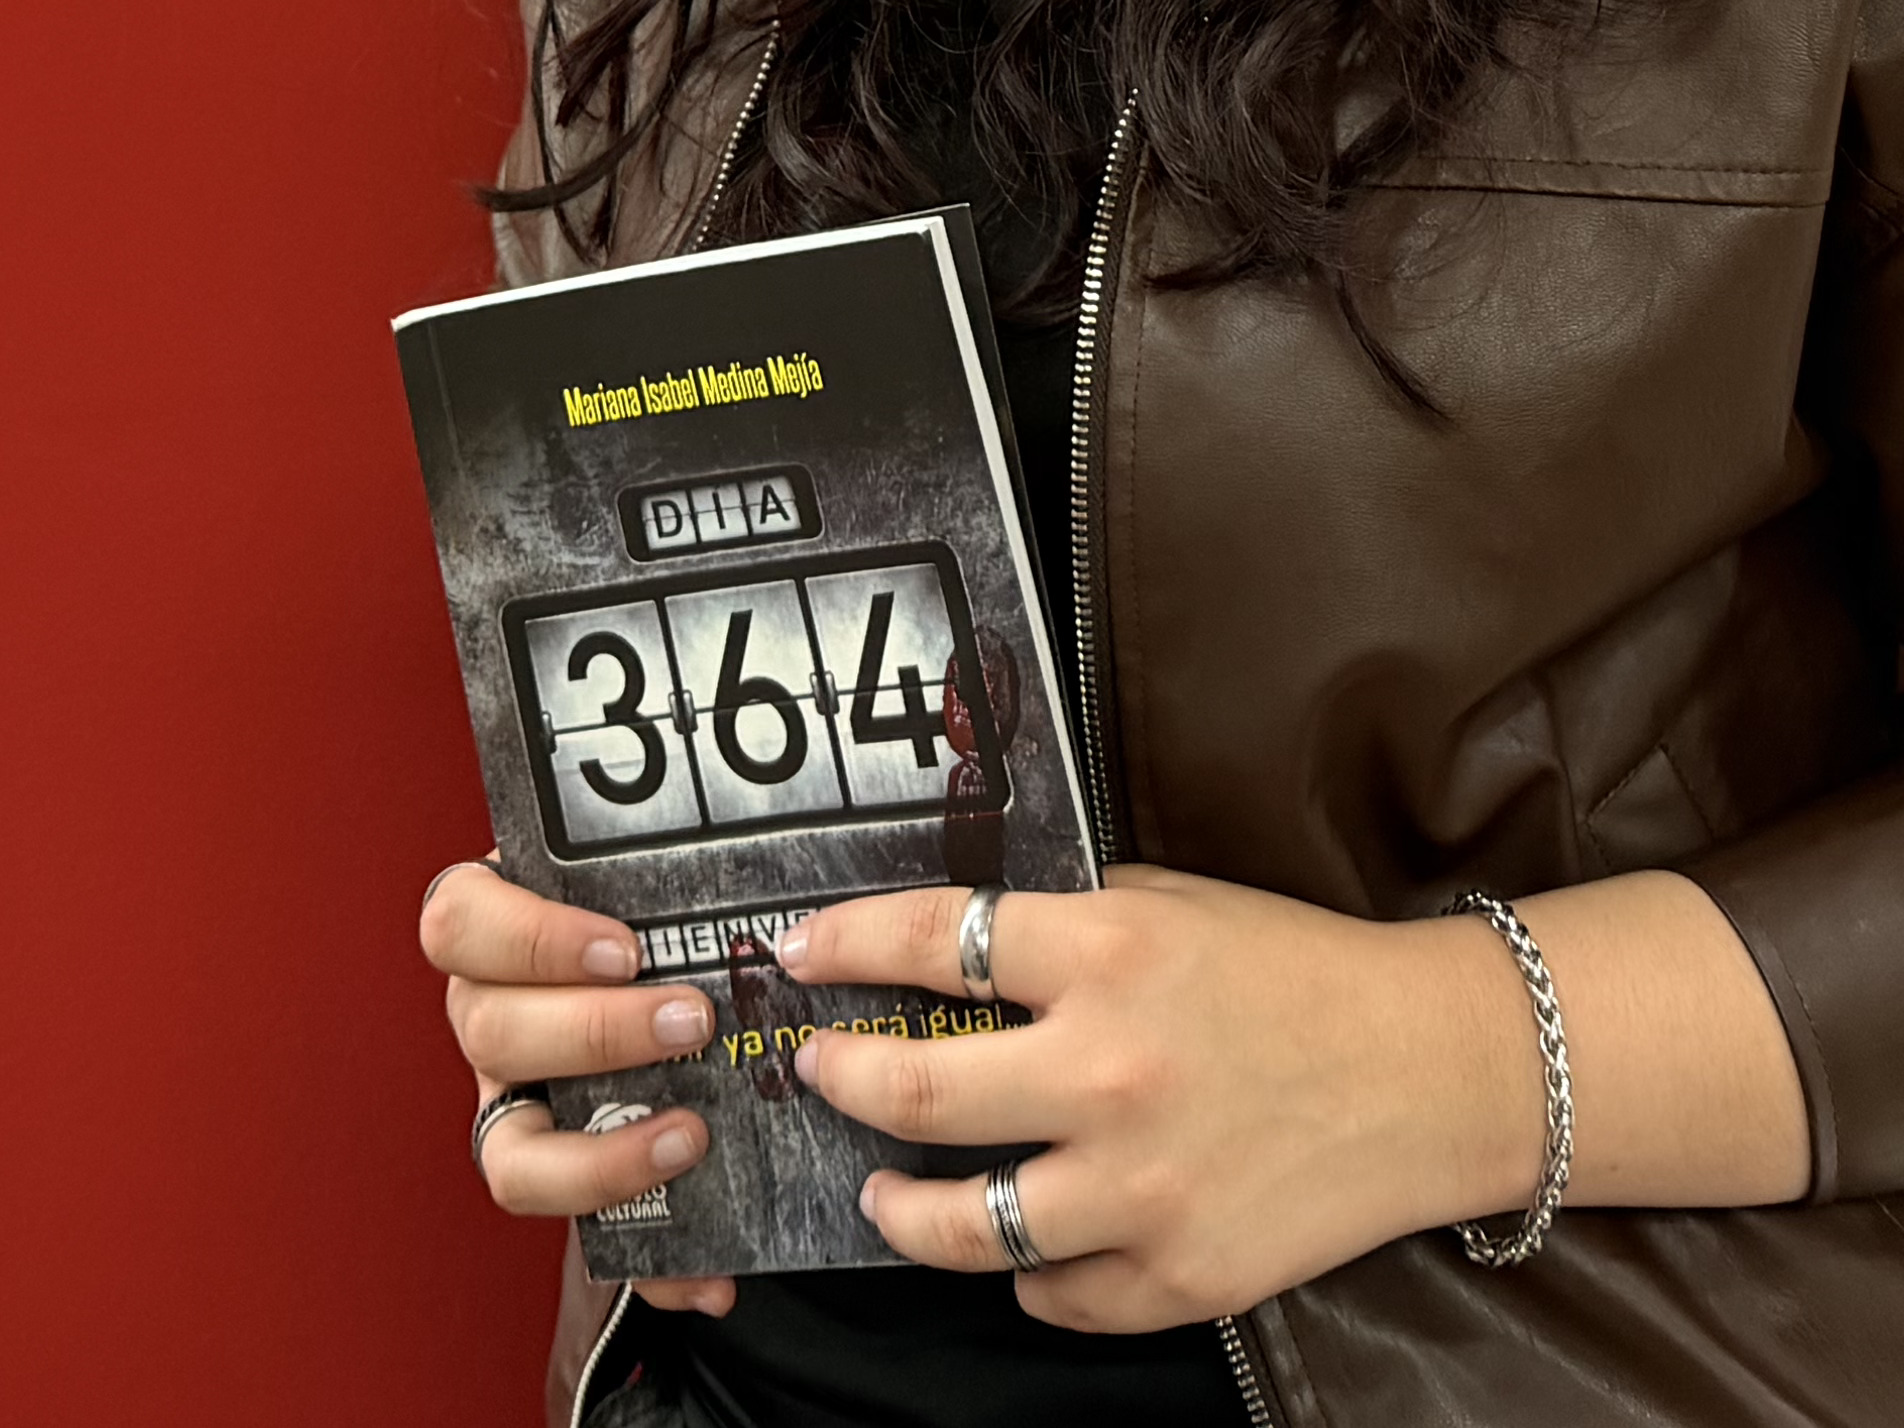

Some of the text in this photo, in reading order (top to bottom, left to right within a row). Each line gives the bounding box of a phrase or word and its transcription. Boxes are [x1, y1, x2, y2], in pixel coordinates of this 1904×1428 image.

[563, 352, 824, 427] Mariana Isabel Medina Mejía
[568, 591, 946, 806] 364
[723, 1029, 764, 1067] ya
